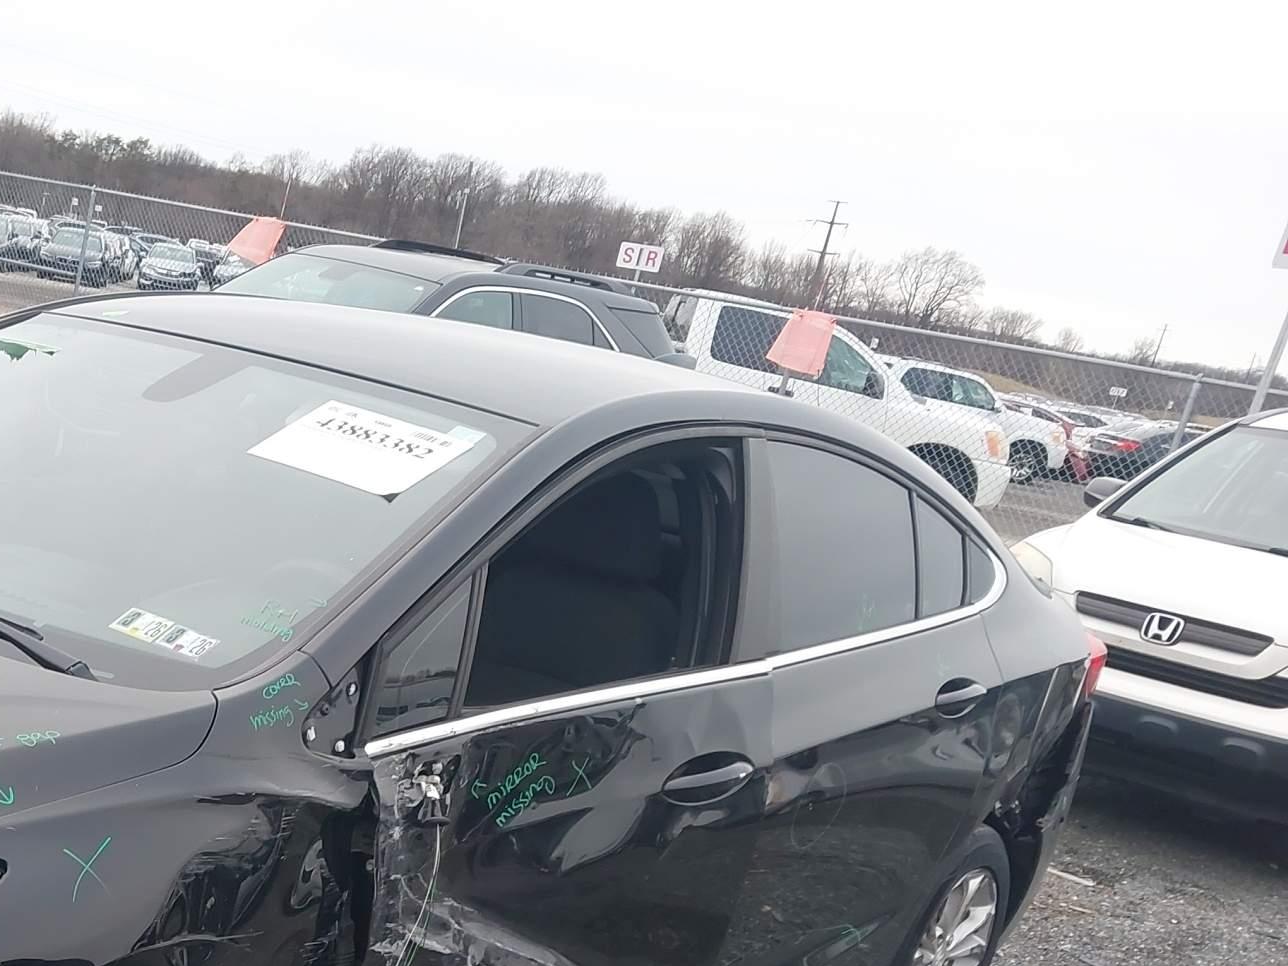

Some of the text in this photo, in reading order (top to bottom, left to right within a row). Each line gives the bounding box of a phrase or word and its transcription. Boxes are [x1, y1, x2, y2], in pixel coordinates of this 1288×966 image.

[316, 417, 435, 459] 43883382
[249, 705, 295, 731] missing
[16, 730, 61, 747] gap
[495, 775, 555, 828] missing
